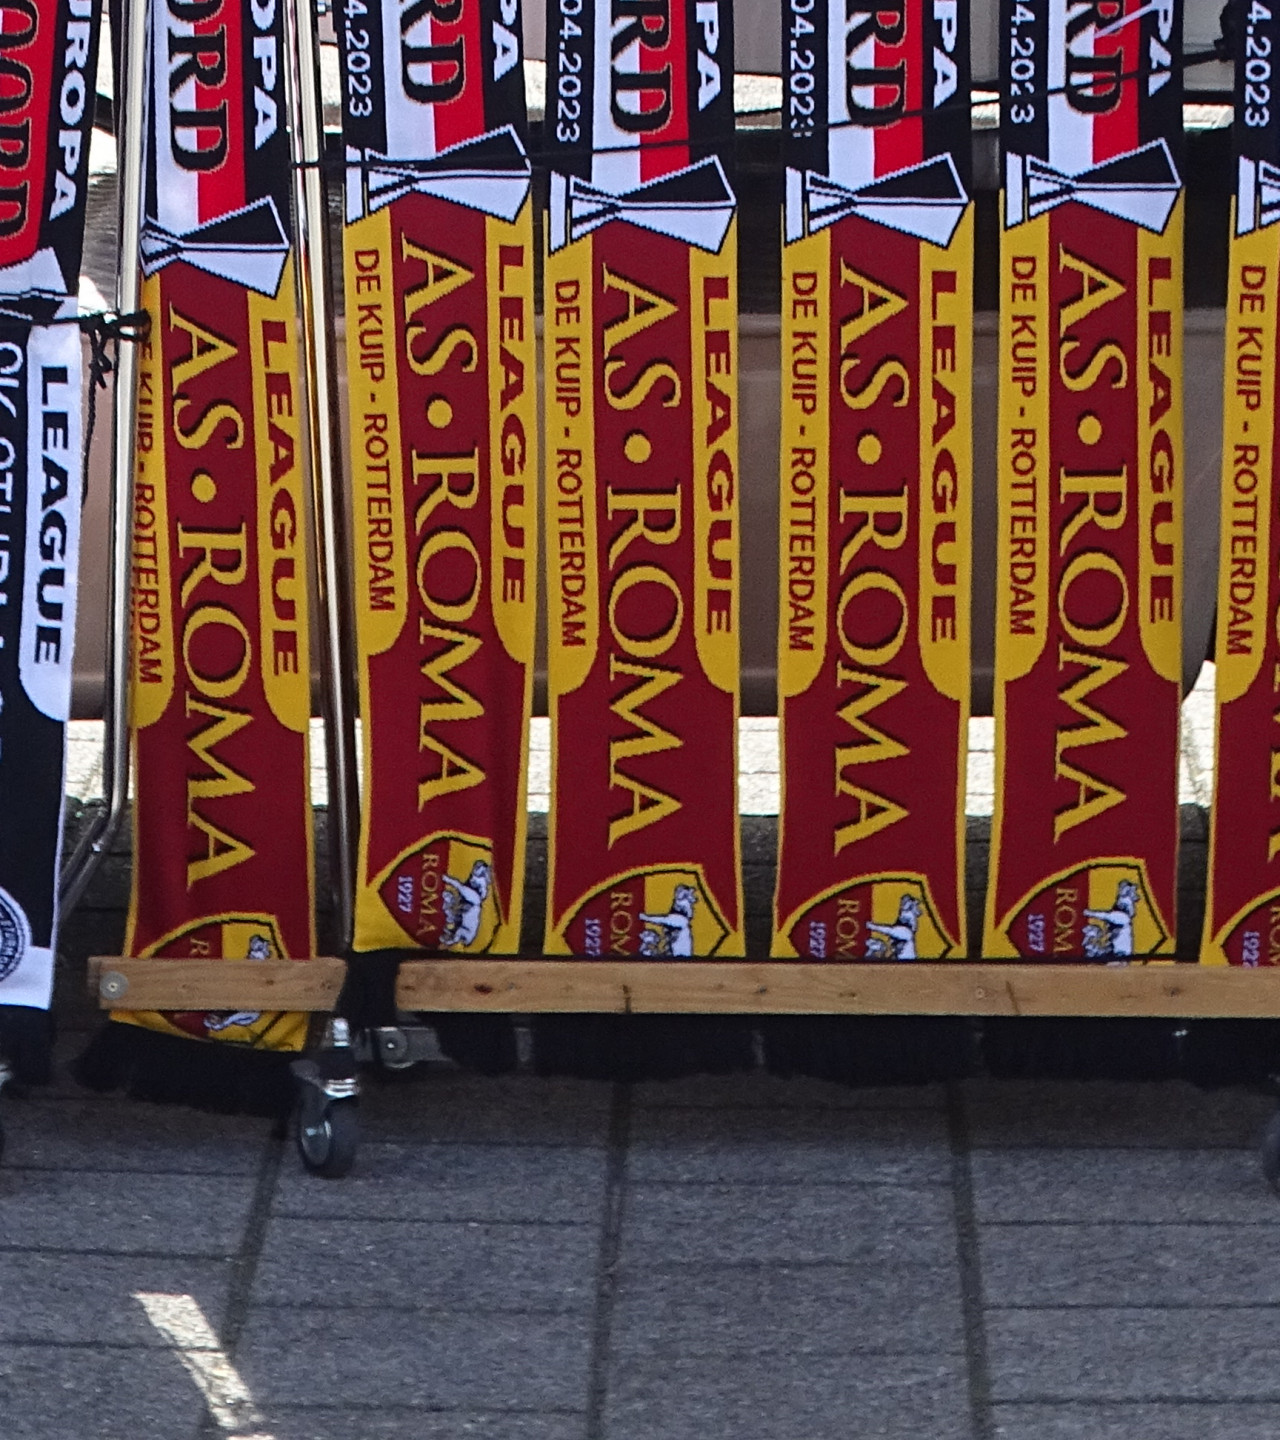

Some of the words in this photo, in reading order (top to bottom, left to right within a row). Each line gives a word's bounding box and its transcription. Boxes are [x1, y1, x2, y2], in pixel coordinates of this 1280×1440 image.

[353, 248, 381, 294] DE
[357, 303, 385, 384] KUIP
[402, 236, 477, 376] AS
[554, 279, 581, 324] DE
[602, 262, 682, 411] AS
[789, 271, 818, 317] DE
[838, 257, 913, 413] AS
[1010, 255, 1037, 303] DE
[1011, 314, 1038, 399] KUIP
[1059, 243, 1129, 391] AS
[1238, 265, 1268, 313] DE
[169, 304, 244, 450] AS
[497, 244, 527, 605] LEAGUE
[555, 335, 583, 419] KUIP
[700, 276, 734, 636] LEAGUE
[790, 330, 819, 416] KUIP
[930, 269, 958, 643] LEAGUE
[1145, 257, 1176, 625] LEAGUE
[1235, 324, 1266, 411] KUIP
[33, 365, 70, 666] LEAGUE
[261, 320, 298, 677] LEAGUE
[362, 412, 396, 614] ROTTERDAM
[556, 448, 587, 648] ROTTERDAM
[789, 446, 823, 652] ROTTERDAM
[1009, 430, 1038, 636] ROTTERDAM
[1225, 443, 1261, 658] ROTTERDAM
[177, 522, 256, 890] ROMA
[410, 446, 488, 814] ROMA
[605, 482, 685, 851] ROMA
[834, 482, 913, 858] ROMA
[1054, 465, 1129, 844] ROMA
[417, 852, 440, 938] ROMA
